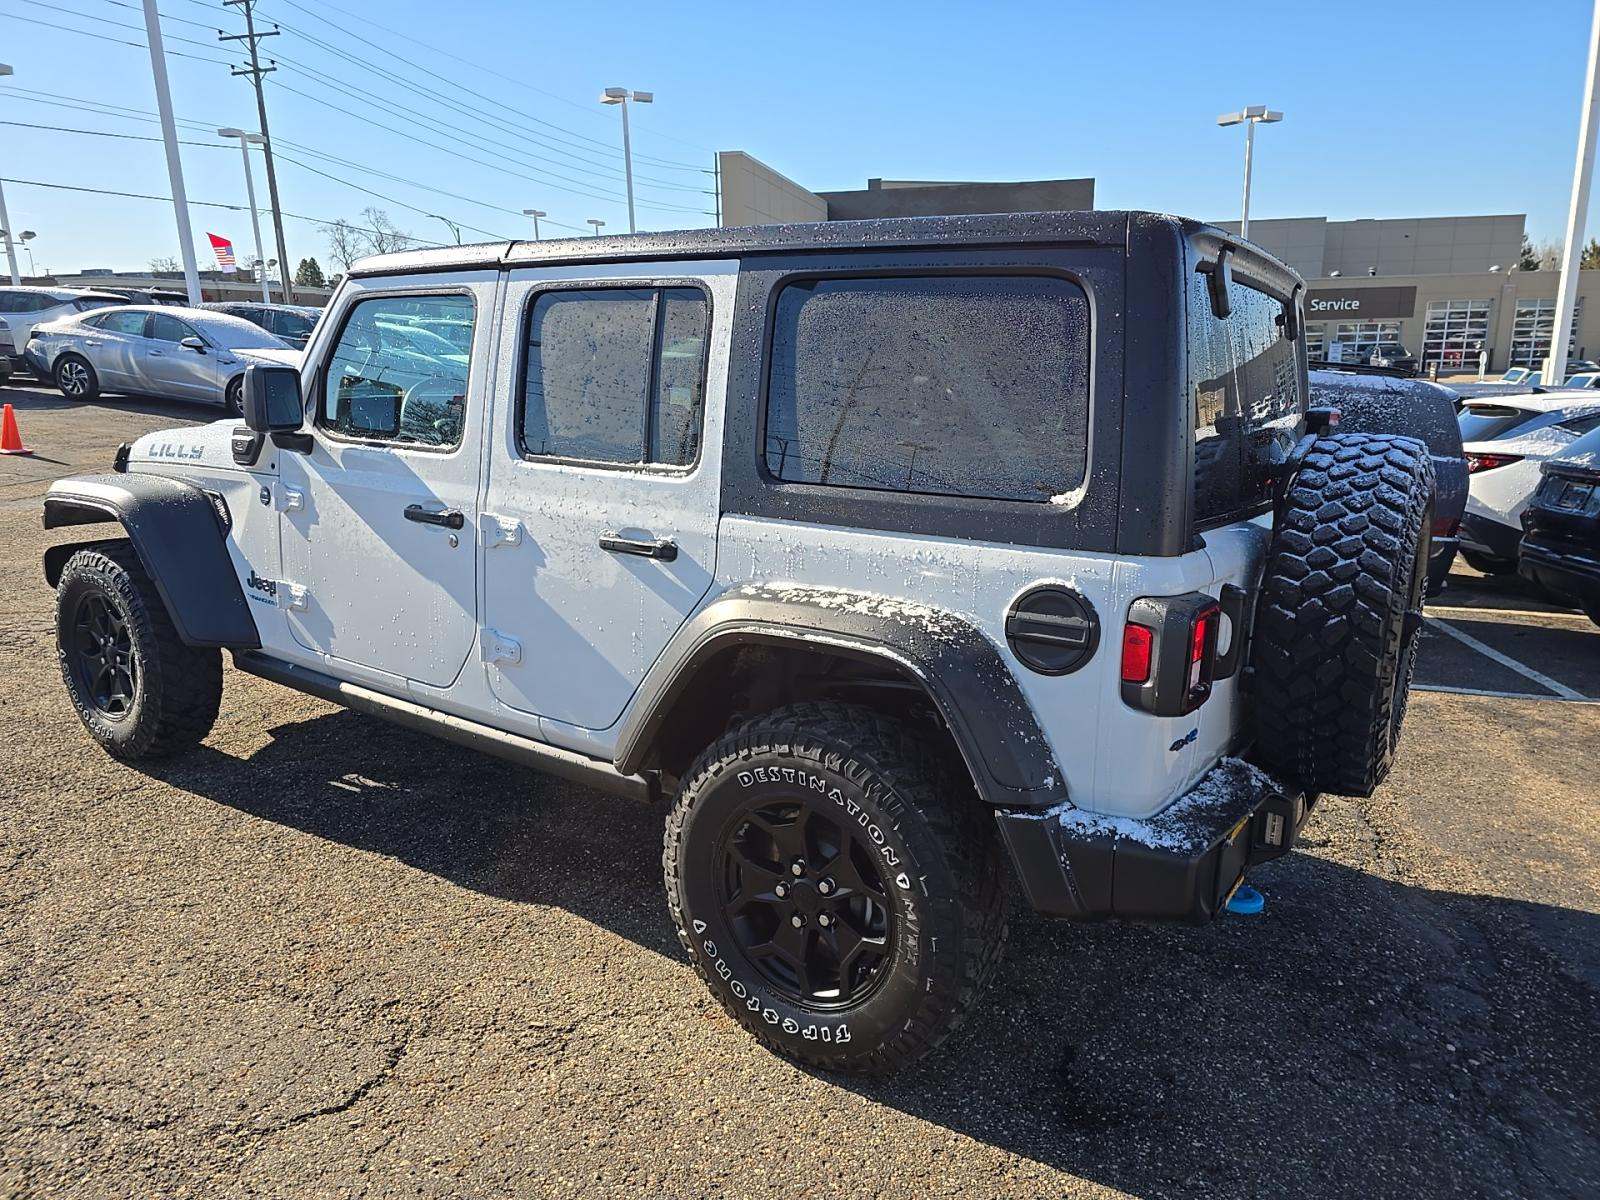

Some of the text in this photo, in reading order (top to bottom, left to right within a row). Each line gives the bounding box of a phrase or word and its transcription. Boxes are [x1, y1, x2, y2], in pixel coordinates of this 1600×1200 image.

[1310, 298, 1360, 311] Service
[246, 569, 277, 597] Jeep
[736, 766, 900, 867] DESTINATION
